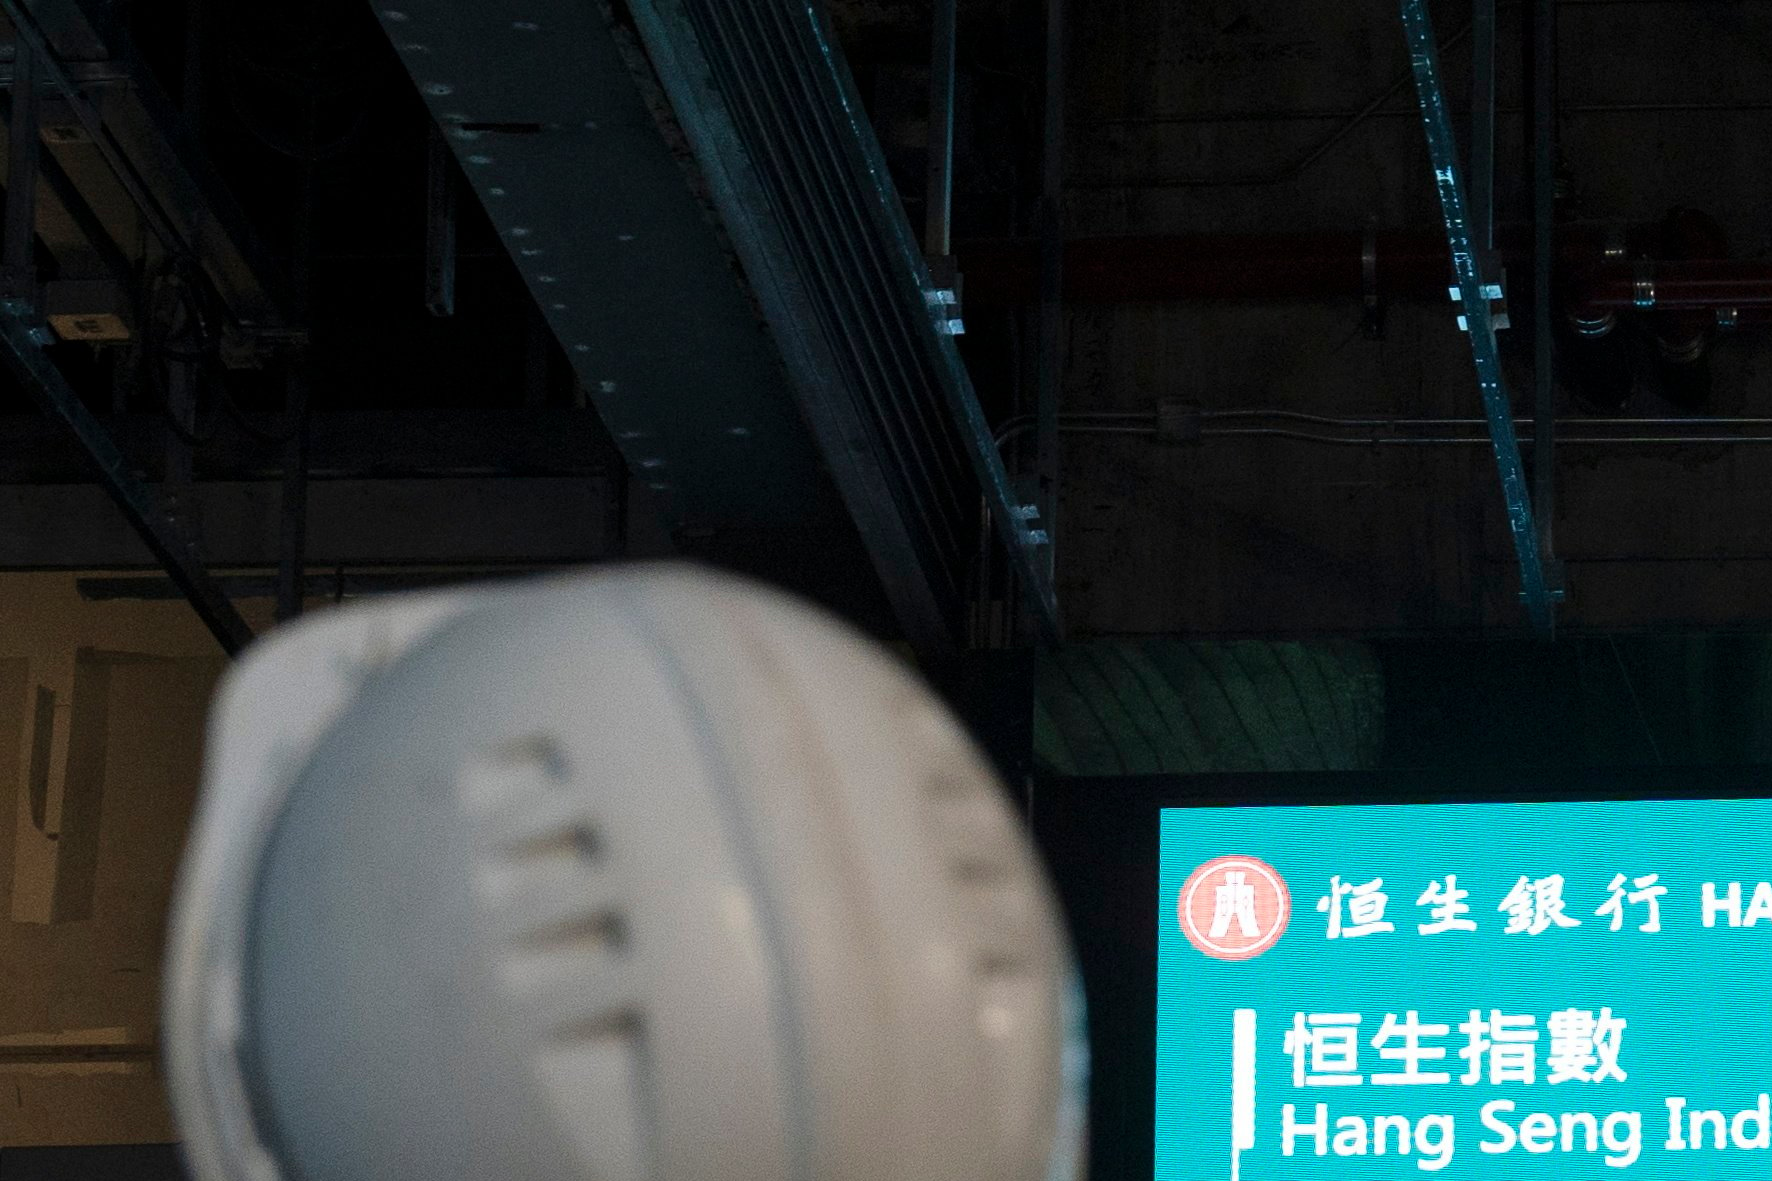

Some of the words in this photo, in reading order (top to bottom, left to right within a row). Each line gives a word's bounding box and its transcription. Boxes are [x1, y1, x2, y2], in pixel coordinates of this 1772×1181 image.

[1316, 874, 1667, 939] 恒生銀行
[1283, 1007, 1627, 1087] 恒生指數
[1282, 1103, 1455, 1171] Hang
[1480, 1099, 1641, 1167] Seng
